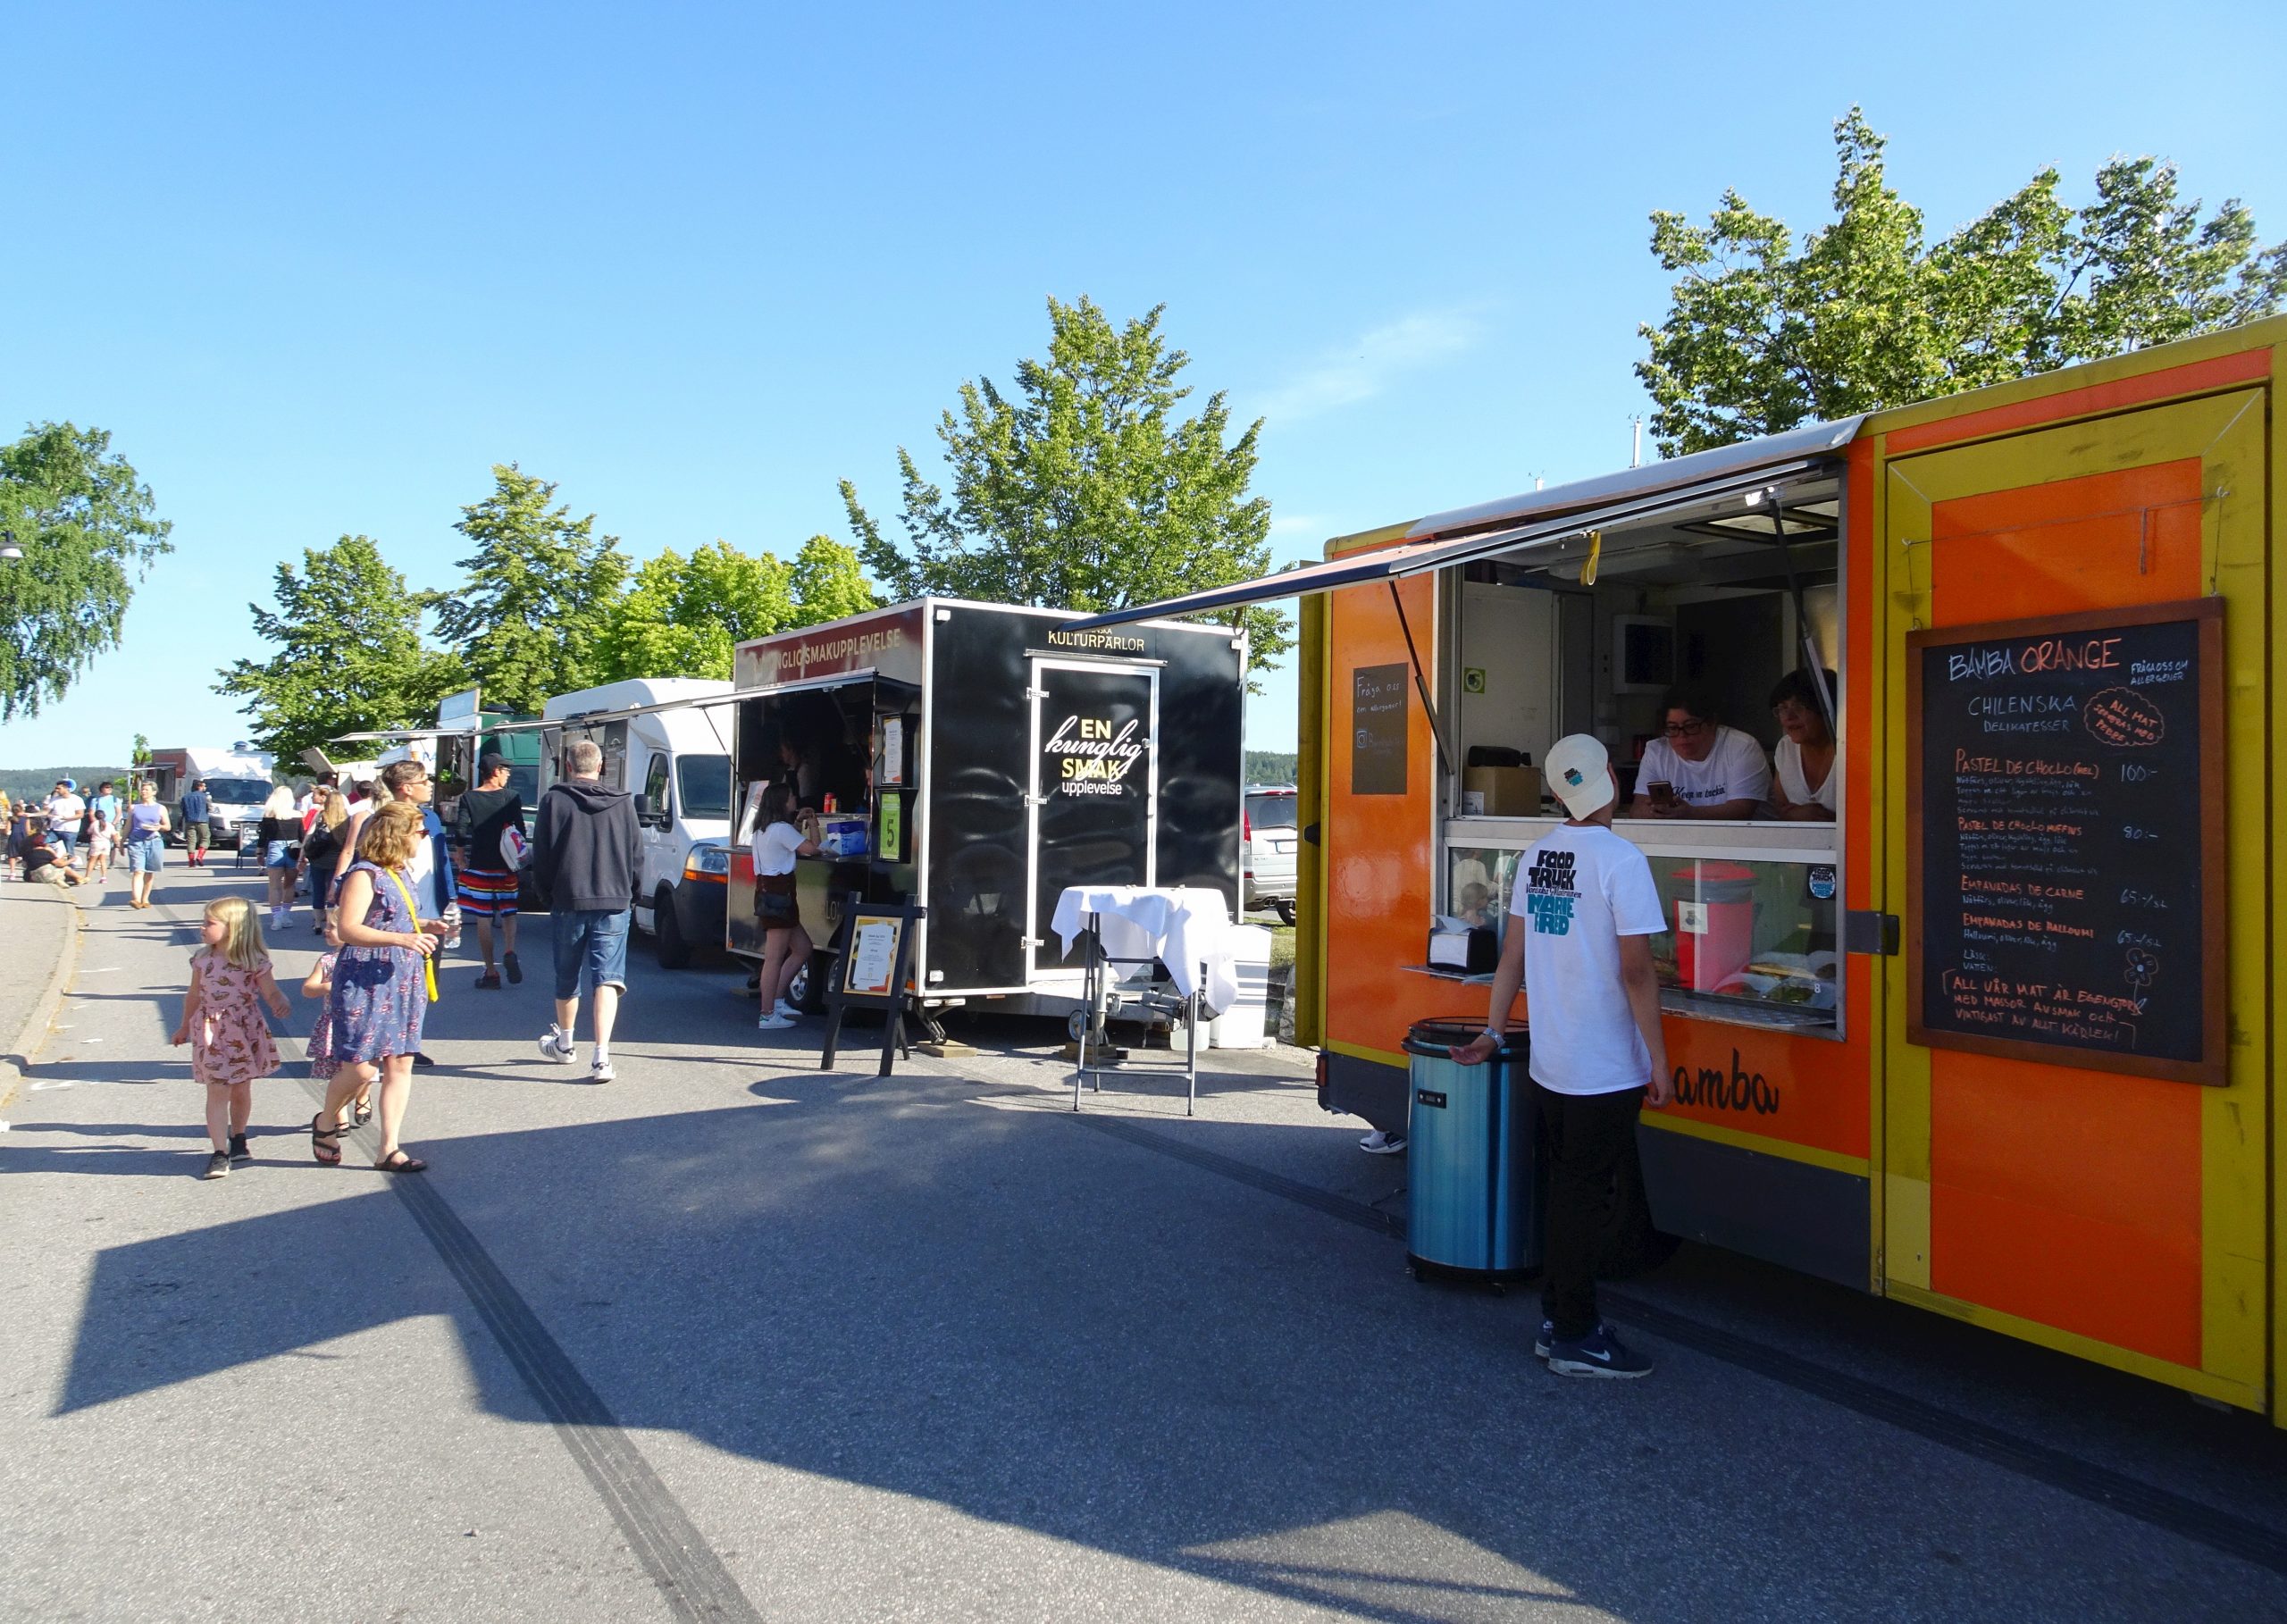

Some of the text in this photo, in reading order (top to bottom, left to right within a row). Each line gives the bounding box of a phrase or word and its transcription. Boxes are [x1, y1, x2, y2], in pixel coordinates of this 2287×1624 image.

[805, 628, 901, 665] SMAKUPPLEVELSE
[1048, 630, 1144, 652] KULTURPÄRLOR
[1948, 638, 2122, 681] BAMBA ORANGE
[1357, 676, 1381, 699] Fråga
[2130, 671, 2184, 685] ALLERGENER
[1968, 695, 2077, 716] CHILENSKA
[2109, 699, 2158, 727] ALL MAT
[1081, 718, 1111, 740] EN
[1984, 719, 2070, 732] DELIKATESSER
[1044, 715, 1143, 783] kunglig
[1061, 758, 1120, 779] SMAK
[1956, 748, 2003, 774] PASTEL
[2006, 759, 2023, 774] DE
[2025, 759, 2072, 775] CHOCLO
[1061, 780, 1123, 797] upplevelse
[886, 818, 895, 848] 5
[1958, 816, 1989, 831] PASTEL
[1992, 820, 2005, 832] DE
[2047, 824, 2082, 836] MUFFINS
[1537, 850, 1575, 869] FOOD
[1528, 866, 1577, 891] TRUCK
[1961, 875, 2084, 900] EMPANADAS DE CARNE
[1528, 893, 1574, 919] MARIE
[1963, 913, 2023, 929] EMPANADAS
[2027, 920, 2042, 931] DE
[1953, 975, 1978, 991] ALL
[1983, 977, 2009, 994] VÅR
[2015, 984, 2048, 998] MAT
[2053, 984, 2073, 1001] ÄR
[1954, 994, 1978, 1006] MED
[1983, 995, 2026, 1009] MASSOR
[2011, 1014, 2027, 1027] AV
[2031, 1017, 2058, 1031] ALLT
[2061, 1022, 2119, 1042] KÄRLEK!
[1673, 1047, 1780, 1115] amba
